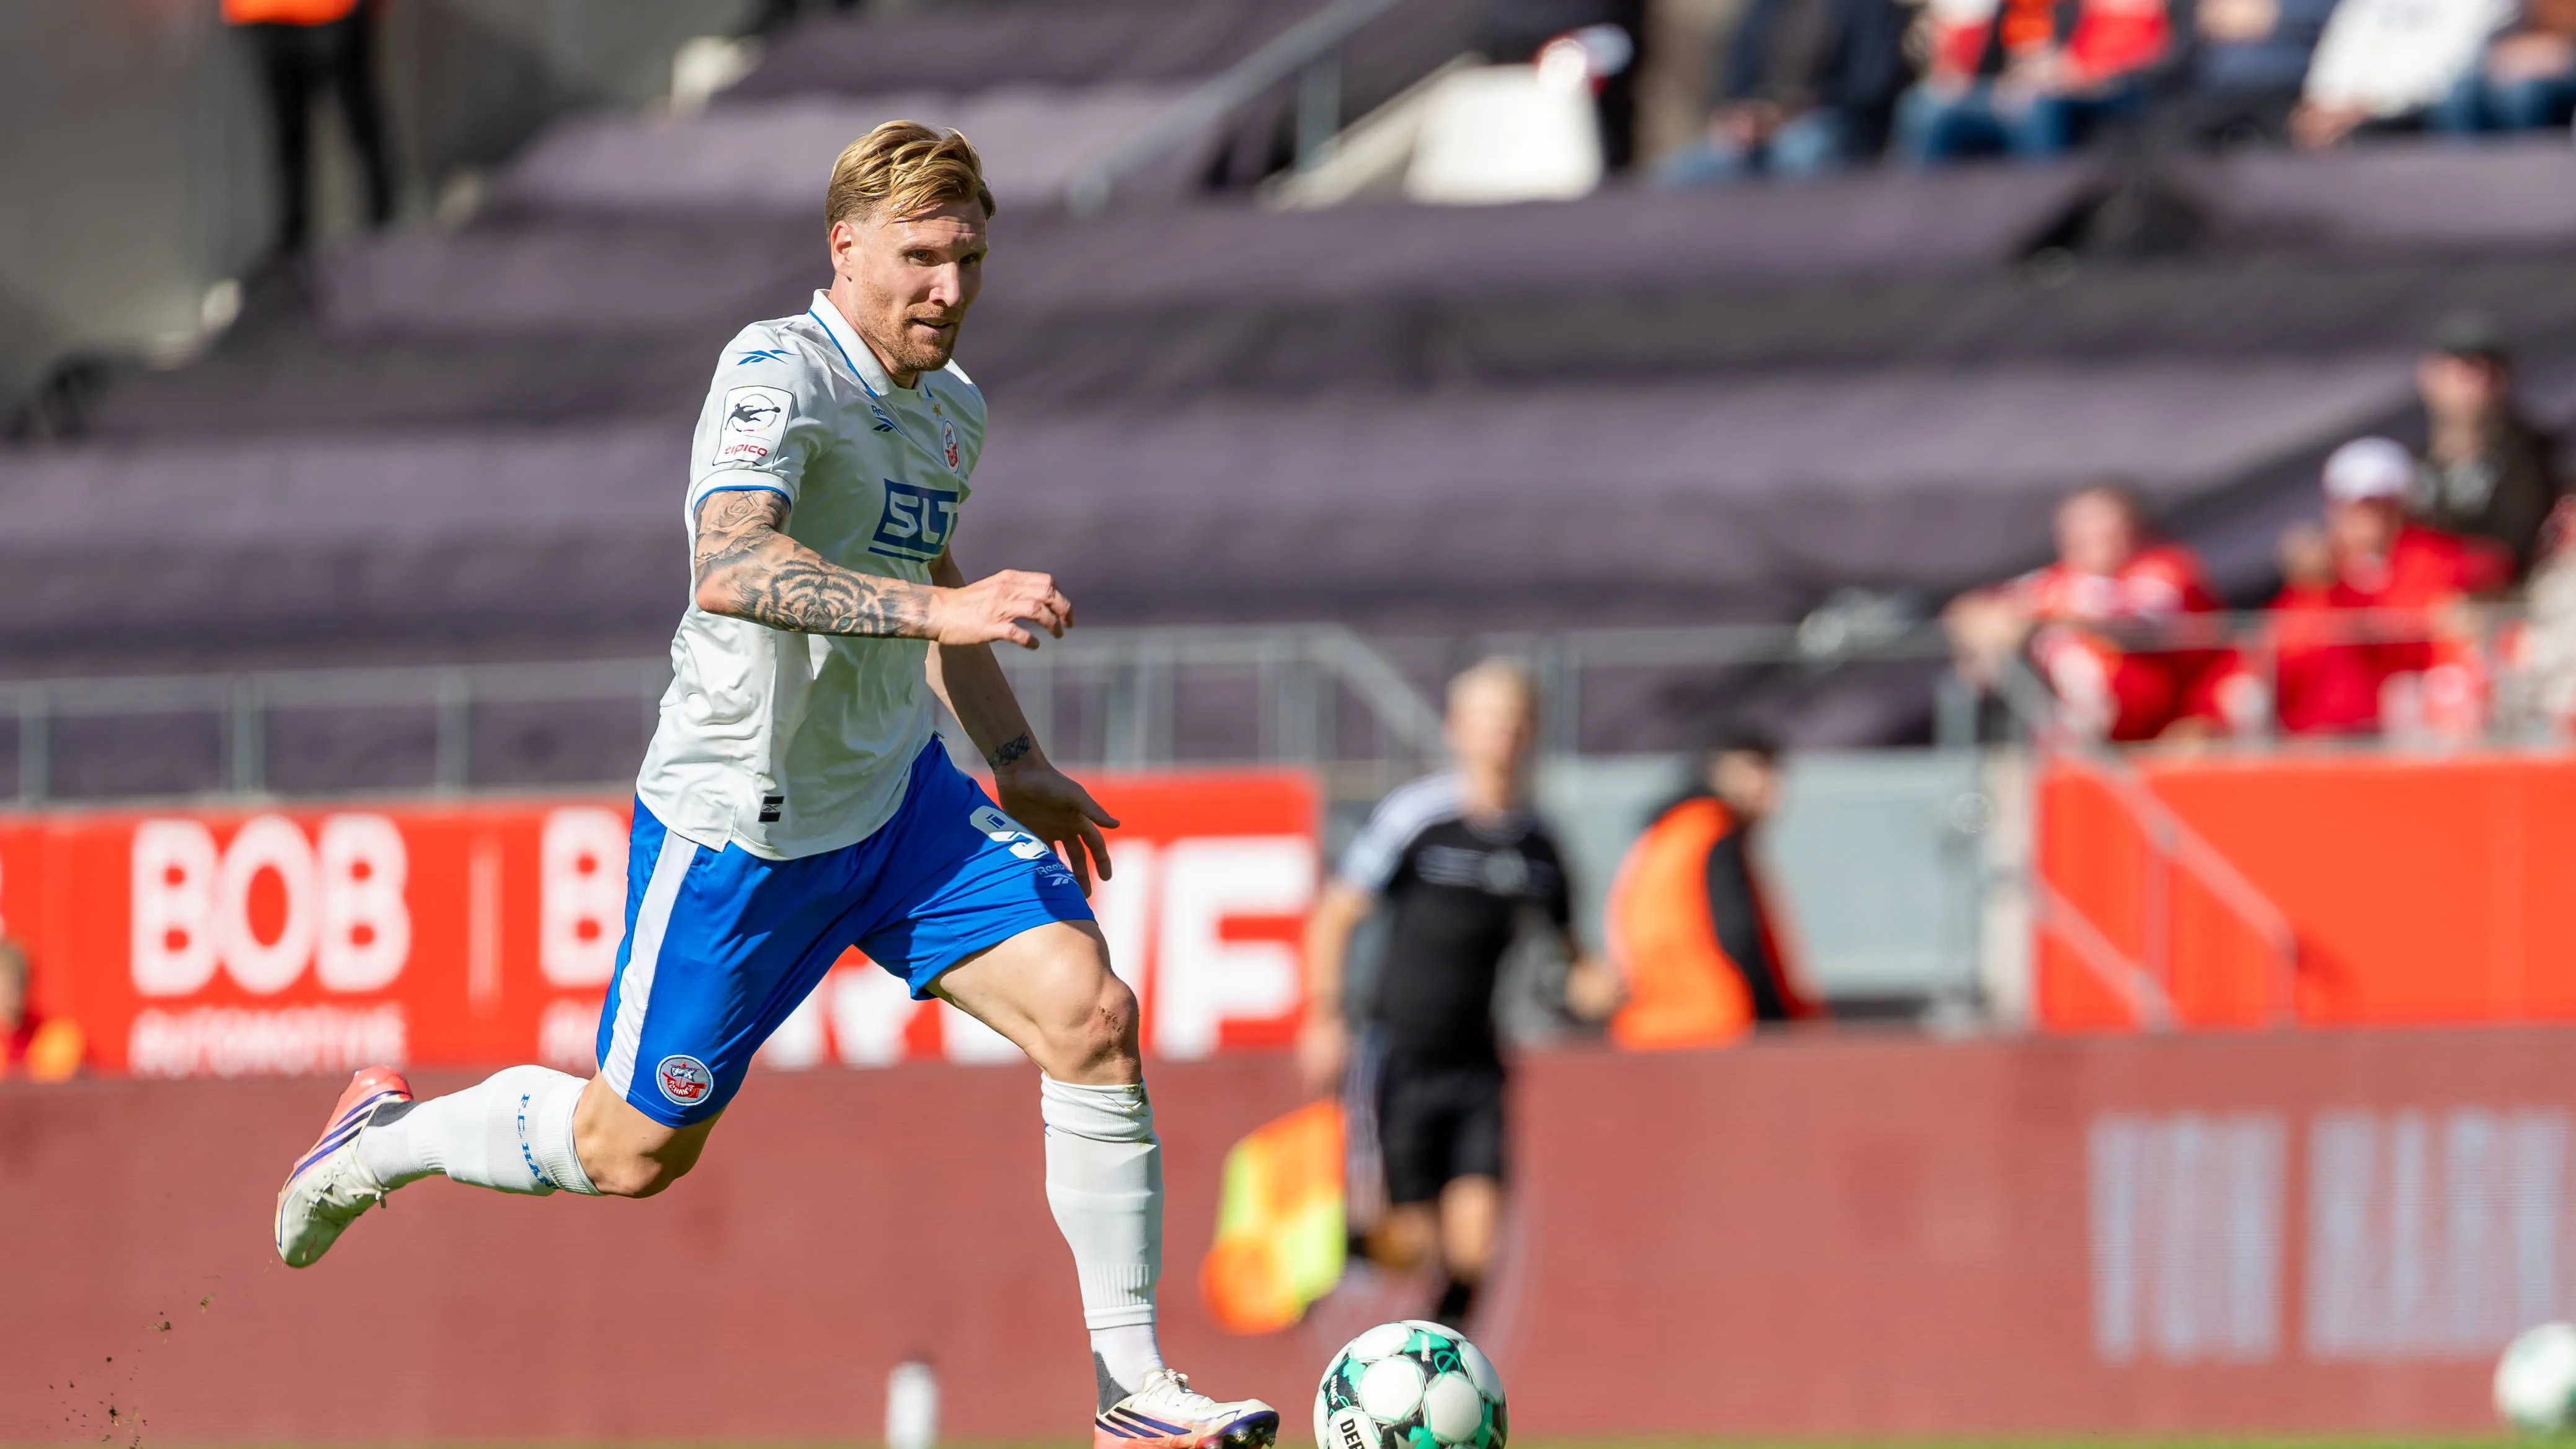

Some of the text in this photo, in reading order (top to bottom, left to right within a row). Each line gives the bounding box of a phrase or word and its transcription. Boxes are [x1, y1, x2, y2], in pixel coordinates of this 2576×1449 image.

[882, 490, 959, 546] SLT
[969, 805, 1050, 860] 9
[130, 814, 411, 995] BOB
